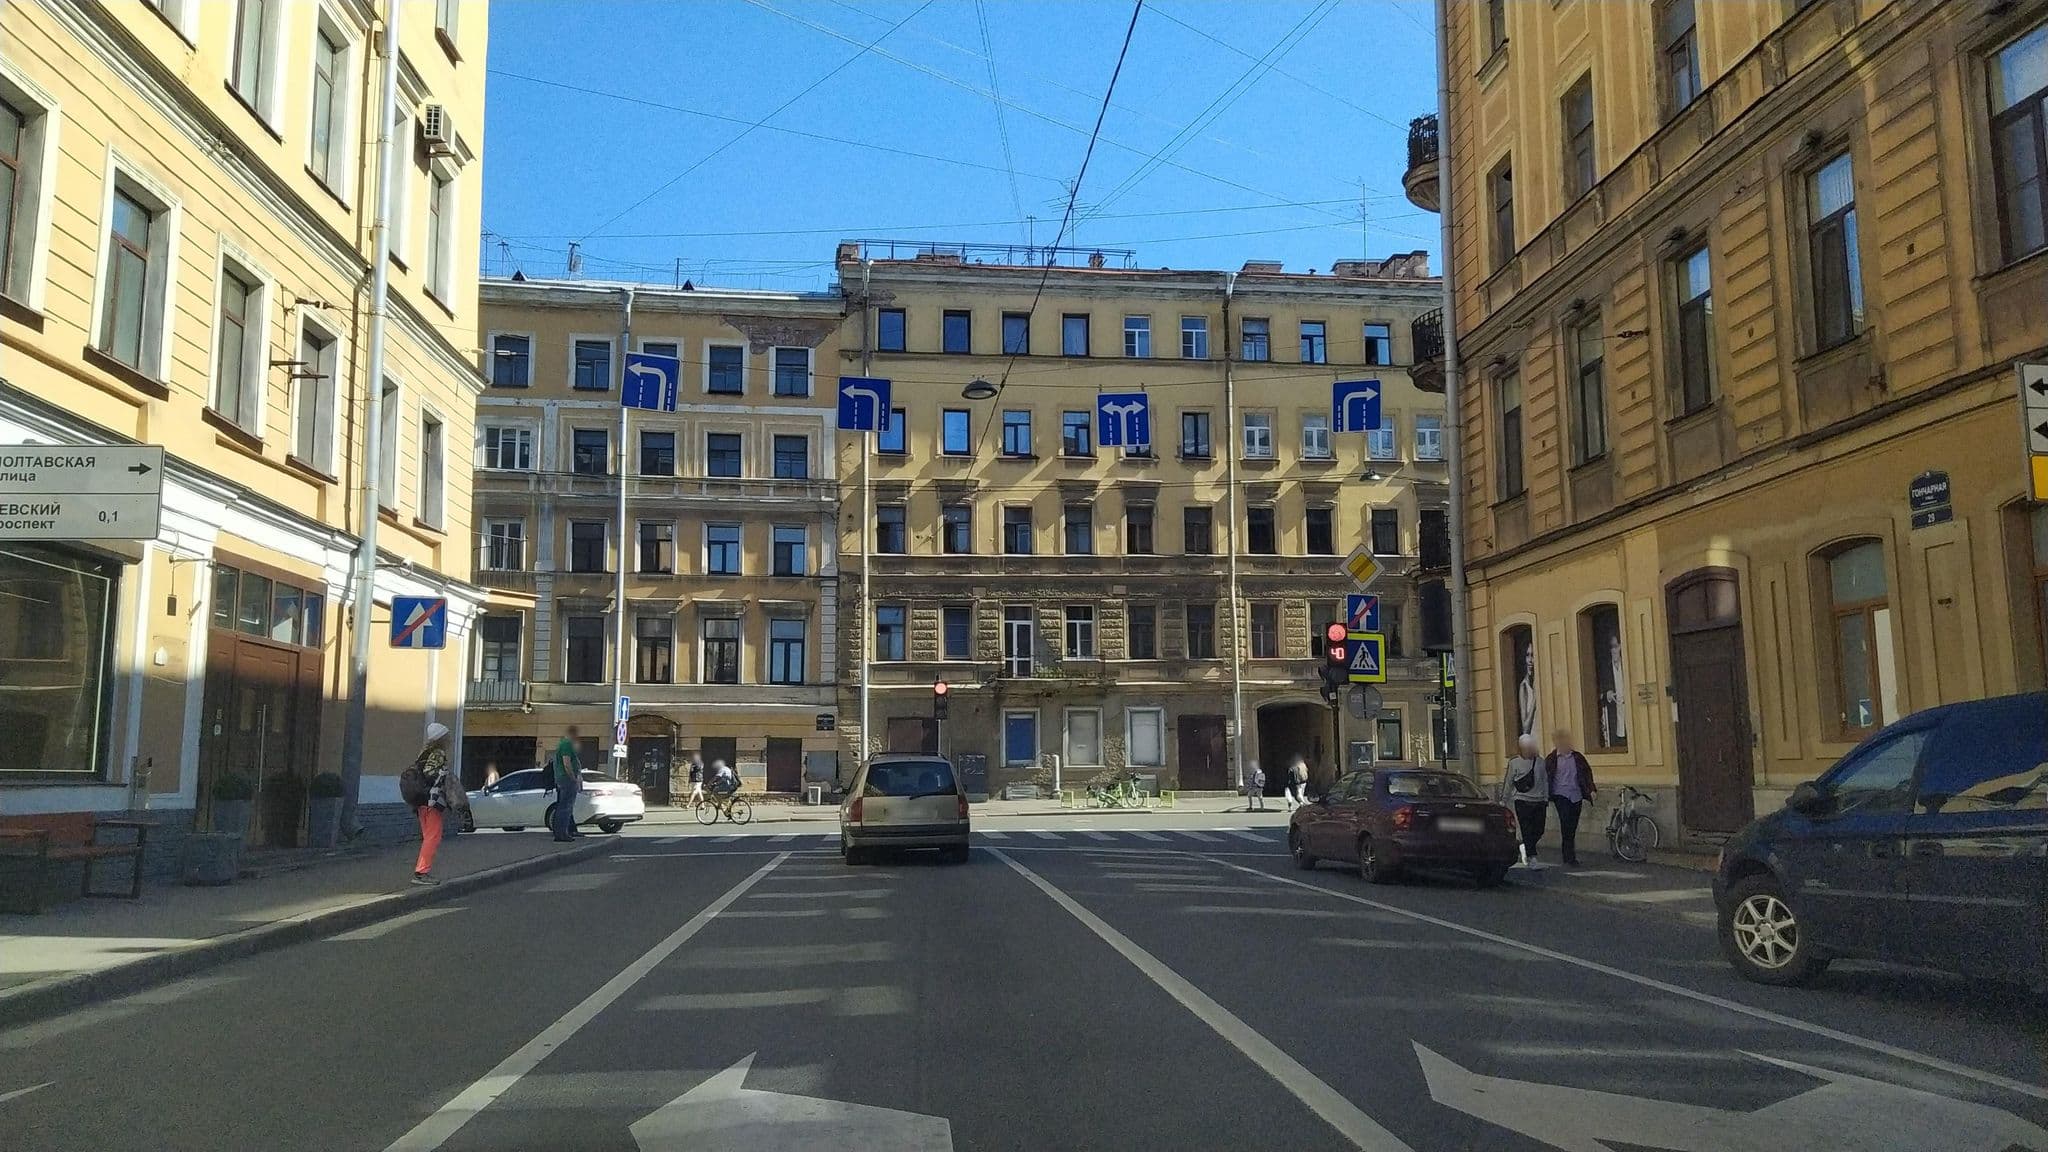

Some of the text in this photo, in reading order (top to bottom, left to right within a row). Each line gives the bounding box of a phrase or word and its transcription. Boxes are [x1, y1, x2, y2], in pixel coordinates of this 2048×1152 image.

[0, 456, 95, 467] ОЛТАВСКАЯ
[0, 472, 36, 482] лица
[0, 501, 61, 515] ЕВСКИЙ
[98, 511, 118, 523] 0,1
[0, 520, 55, 529] оспект
[1331, 647, 1345, 660] 40
